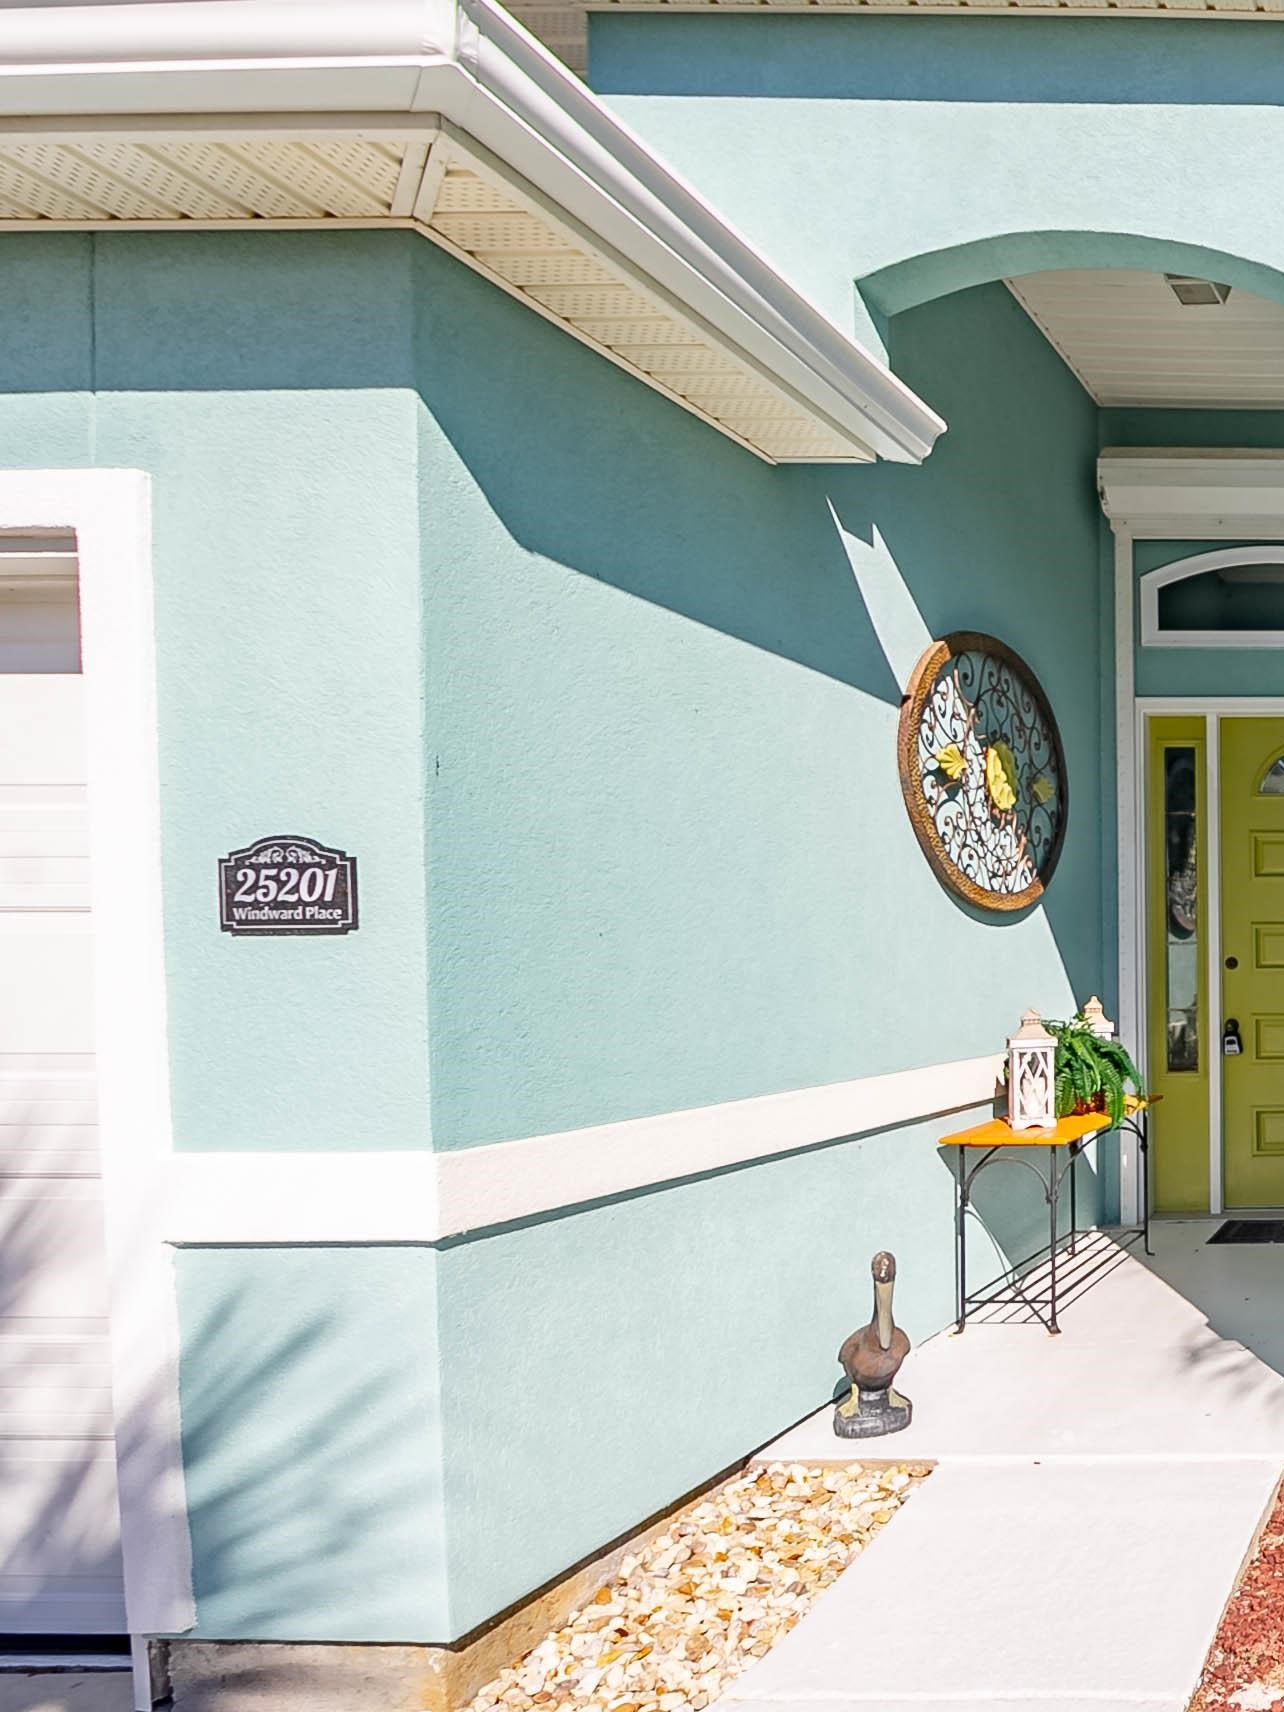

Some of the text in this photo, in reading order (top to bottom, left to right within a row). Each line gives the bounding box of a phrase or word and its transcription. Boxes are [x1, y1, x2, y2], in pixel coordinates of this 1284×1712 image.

[234, 867, 338, 902] 25201
[232, 906, 342, 920] Windward Place
